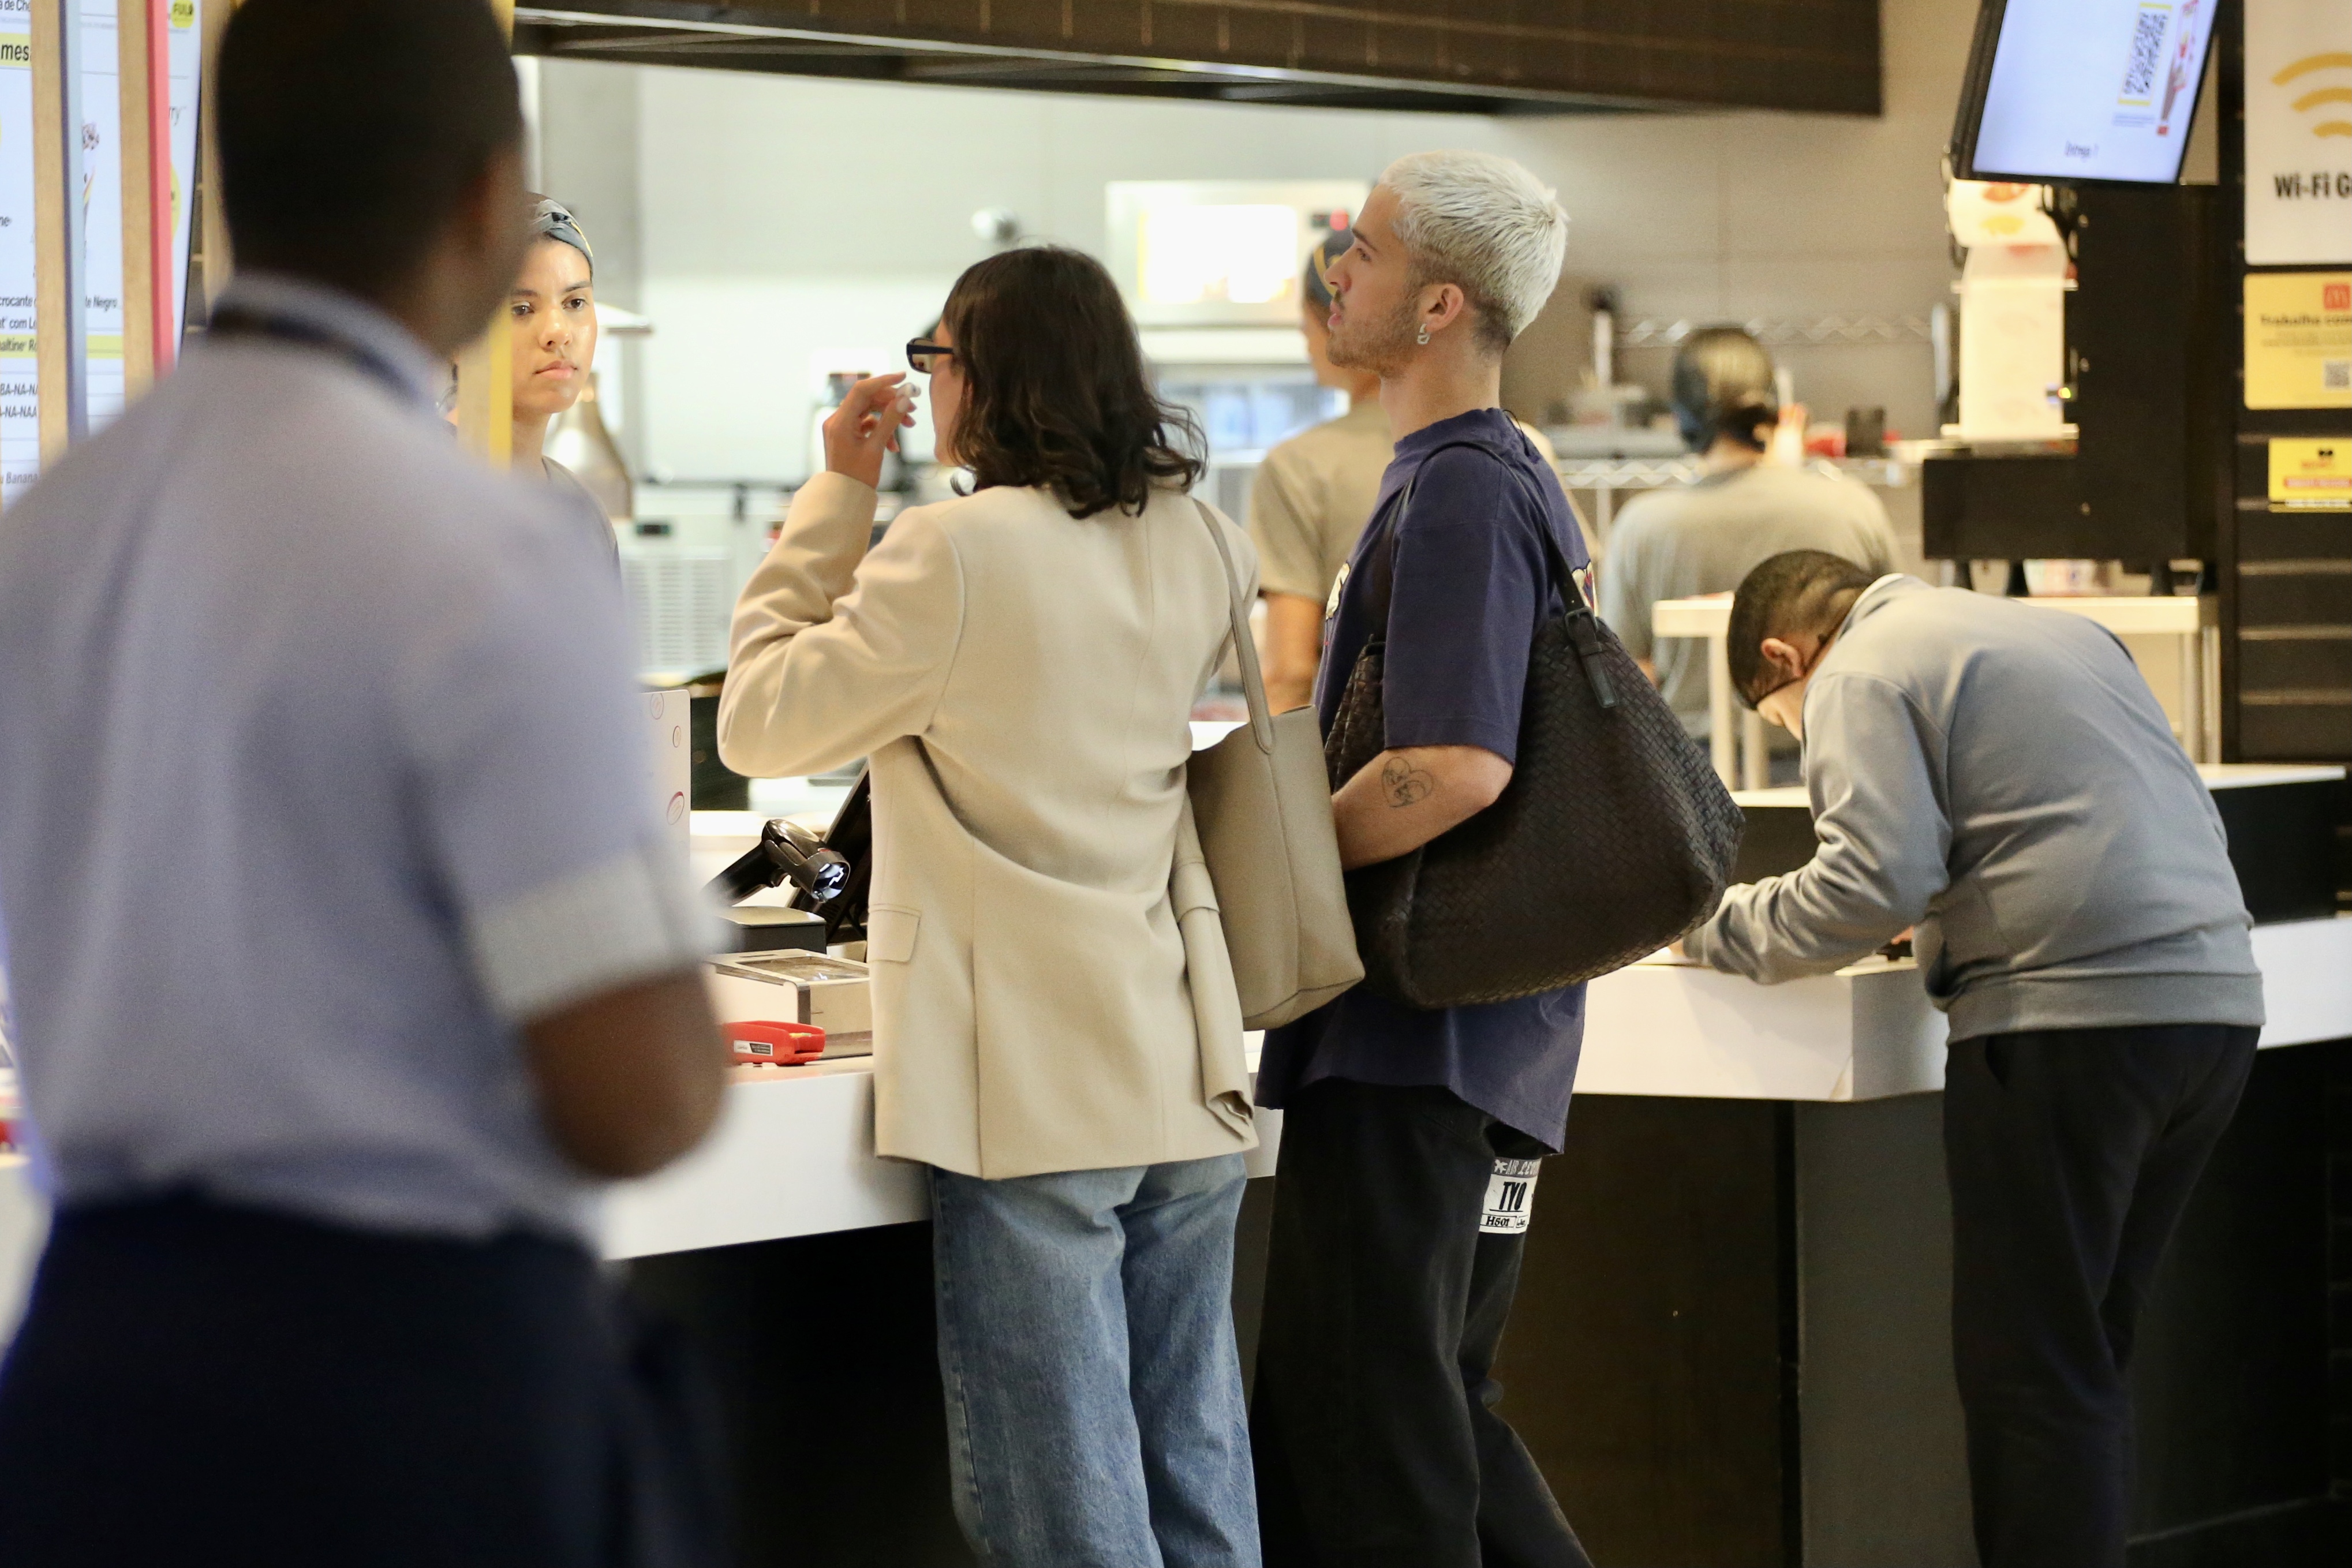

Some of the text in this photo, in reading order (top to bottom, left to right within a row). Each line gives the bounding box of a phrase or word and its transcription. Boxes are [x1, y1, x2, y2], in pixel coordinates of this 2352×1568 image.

[0, 44, 31, 61] mes
[2274, 173, 2352, 198] Wi-Fi G
[9, 319, 27, 329] com
[1499, 1181, 1527, 1211] TYO
